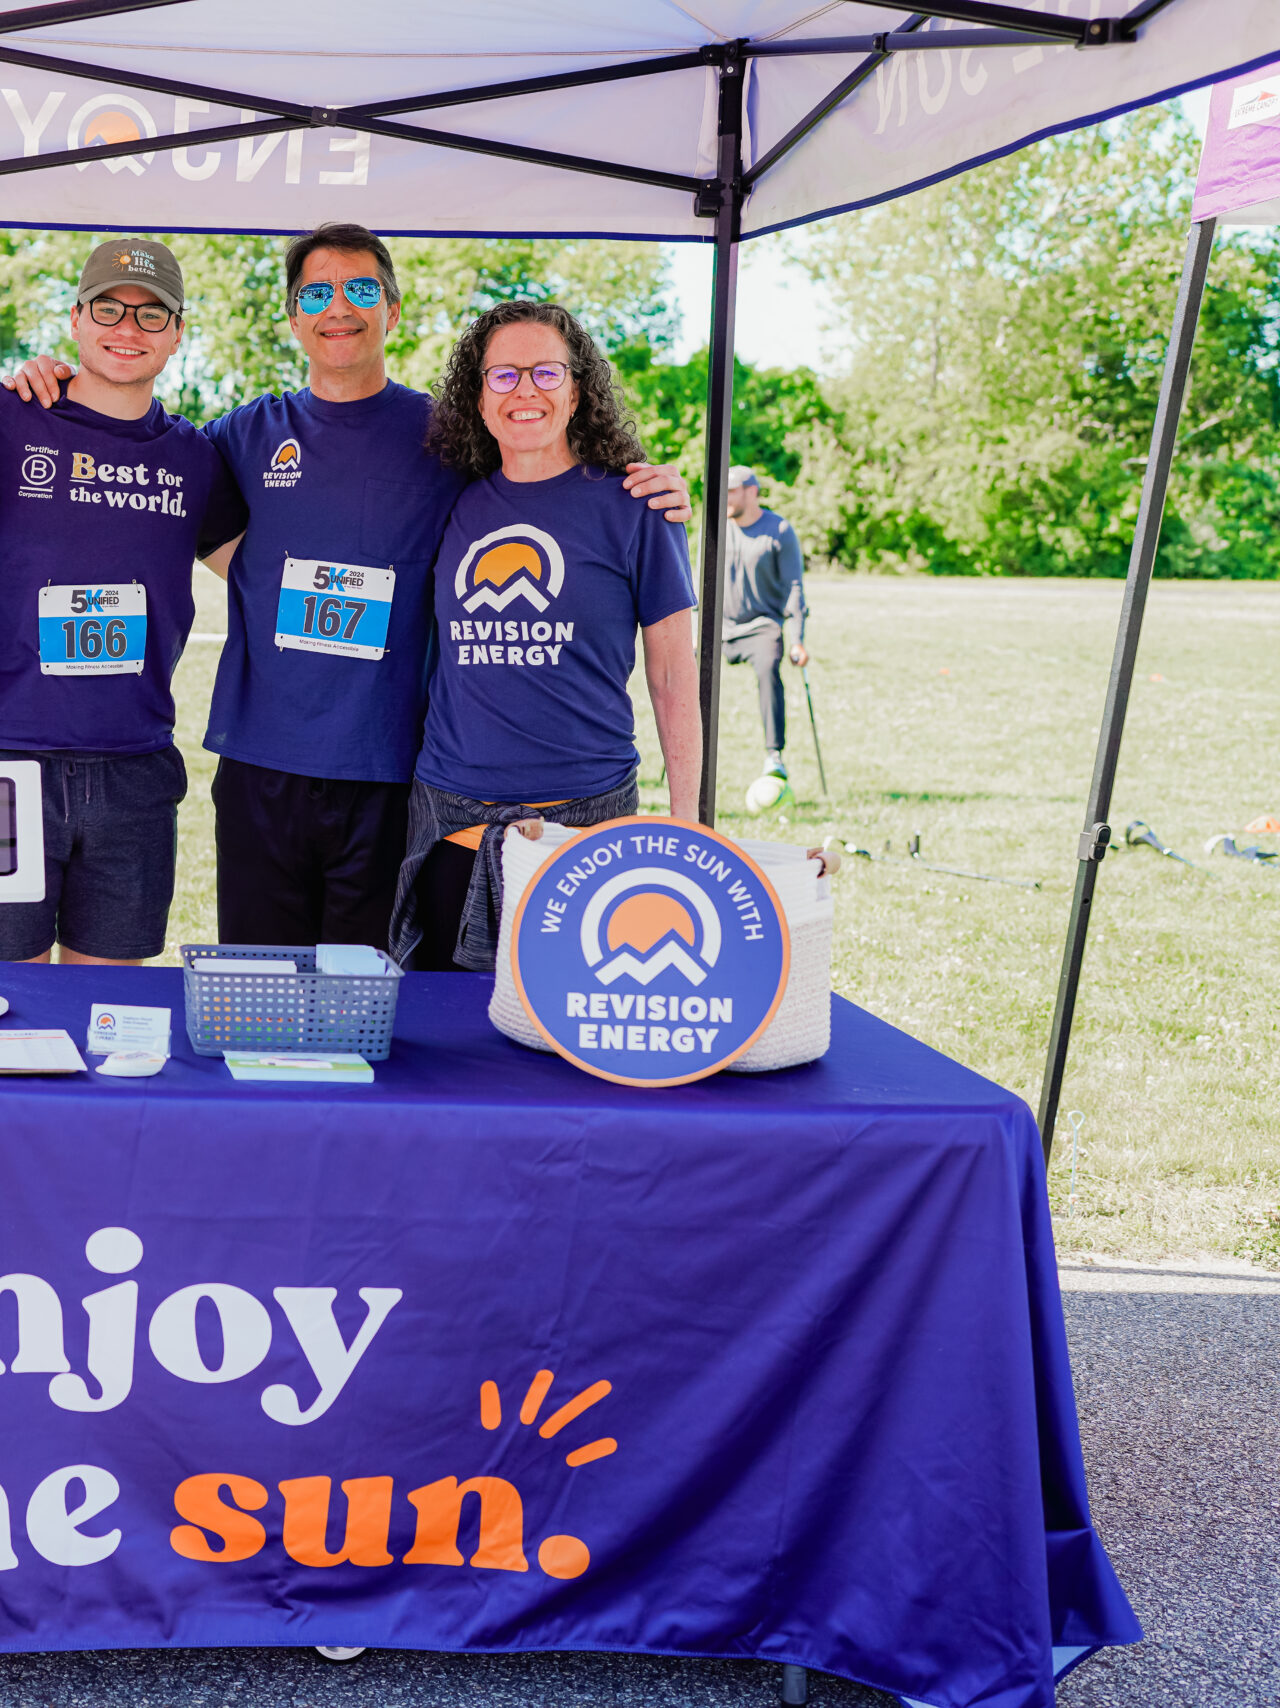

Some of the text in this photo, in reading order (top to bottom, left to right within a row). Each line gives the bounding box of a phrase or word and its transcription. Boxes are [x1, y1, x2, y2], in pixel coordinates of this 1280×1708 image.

[131, 250, 154, 260] Make
[134, 257, 155, 270] life
[128, 265, 157, 277] better.
[24, 444, 59, 456] Certified
[30, 459, 47, 479] B
[70, 452, 183, 488] Best for
[263, 471, 302, 480] REVISION
[264, 479, 297, 487] ENERGY
[18, 490, 53, 499] Corporation
[70, 486, 187, 518] the world.
[313, 565, 348, 592] 5K
[330, 575, 364, 587] UNIFIED
[70, 589, 104, 613] 5K
[87, 596, 120, 605] UNIFIED
[303, 595, 367, 640] 167
[62, 619, 127, 659] 166
[450, 620, 574, 642] REVISION
[458, 644, 563, 666] ENERGY
[540, 835, 765, 941] WE ENJOY THE SUN WITH
[566, 992, 733, 1023] REVISION
[579, 1023, 719, 1053] ENERGY
[170, 1472, 591, 1580] sun.
